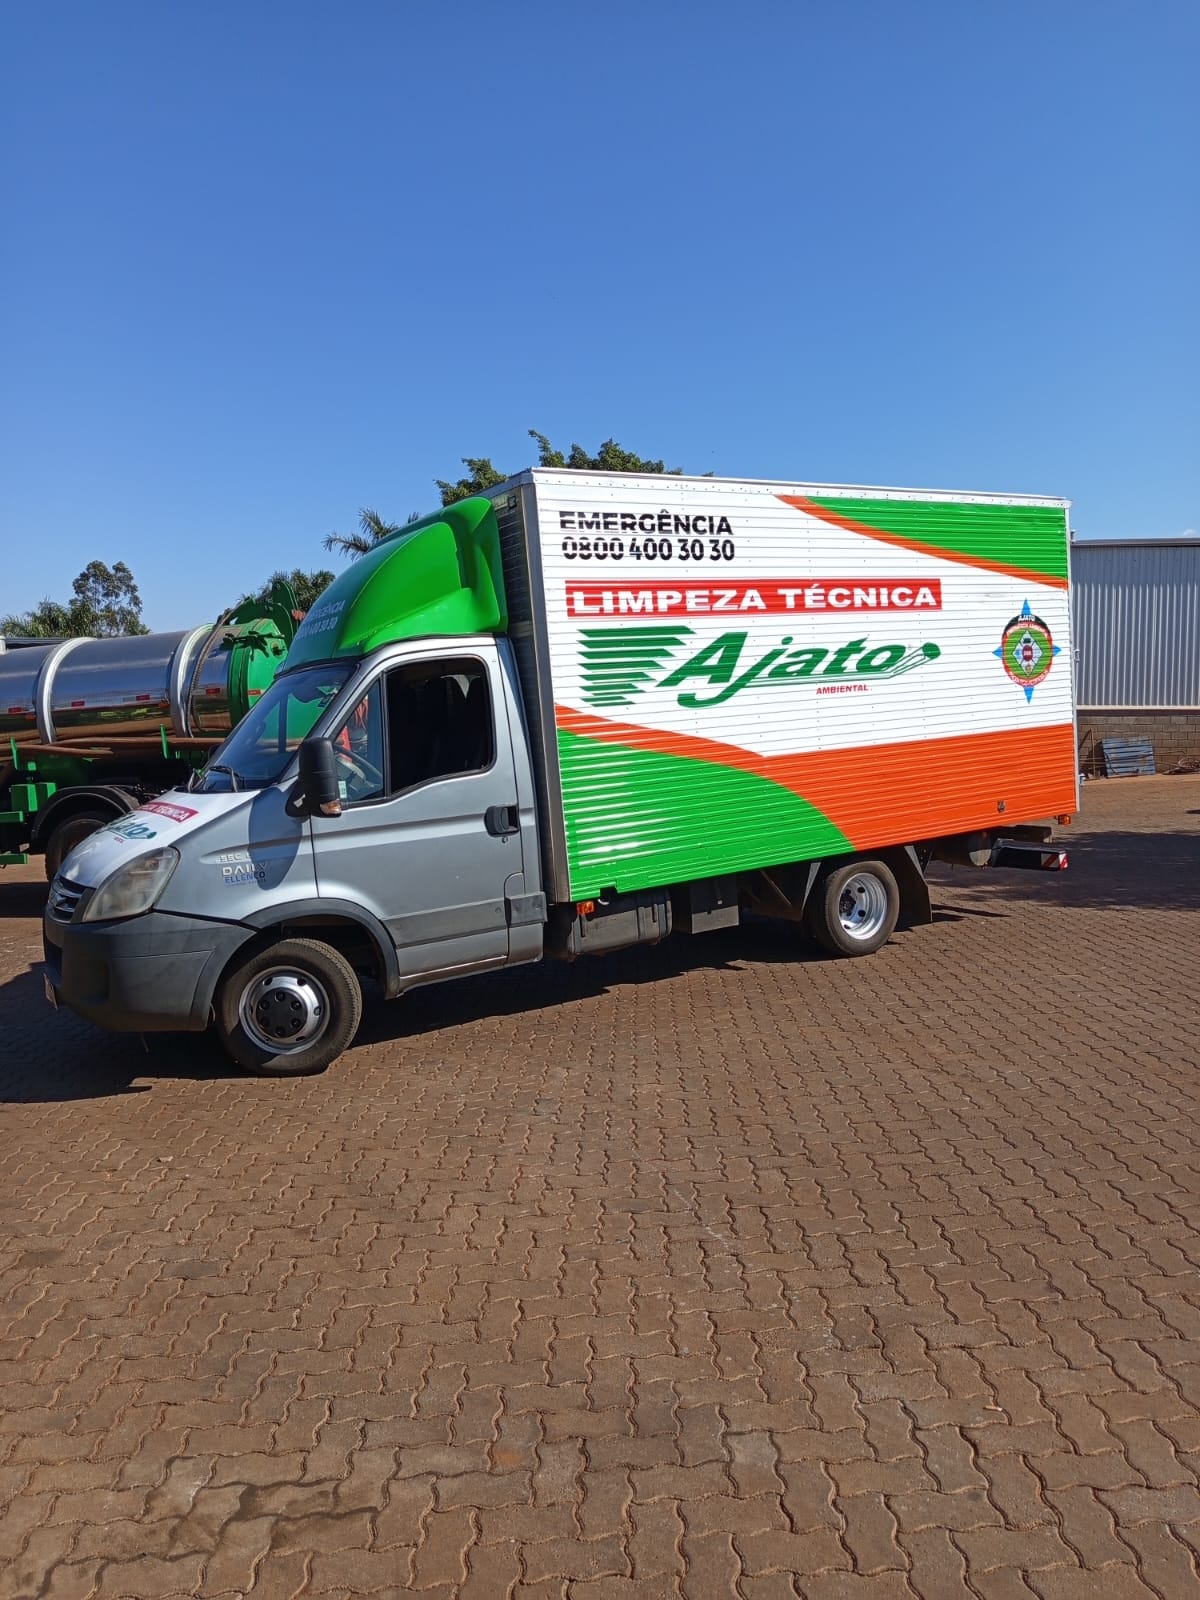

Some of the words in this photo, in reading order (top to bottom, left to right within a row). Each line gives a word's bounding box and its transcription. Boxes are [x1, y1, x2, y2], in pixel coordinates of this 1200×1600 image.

[559, 509, 733, 535] EMERGÊNCIA
[562, 536, 624, 560] 0800
[629, 538, 673, 560] 400
[677, 538, 705, 561] 30
[709, 539, 735, 561] 30
[573, 588, 767, 614] LIMPEZA
[778, 583, 937, 609] TÉCNICA
[655, 631, 908, 708] Ajato
[816, 684, 869, 695] AMBIENTAL
